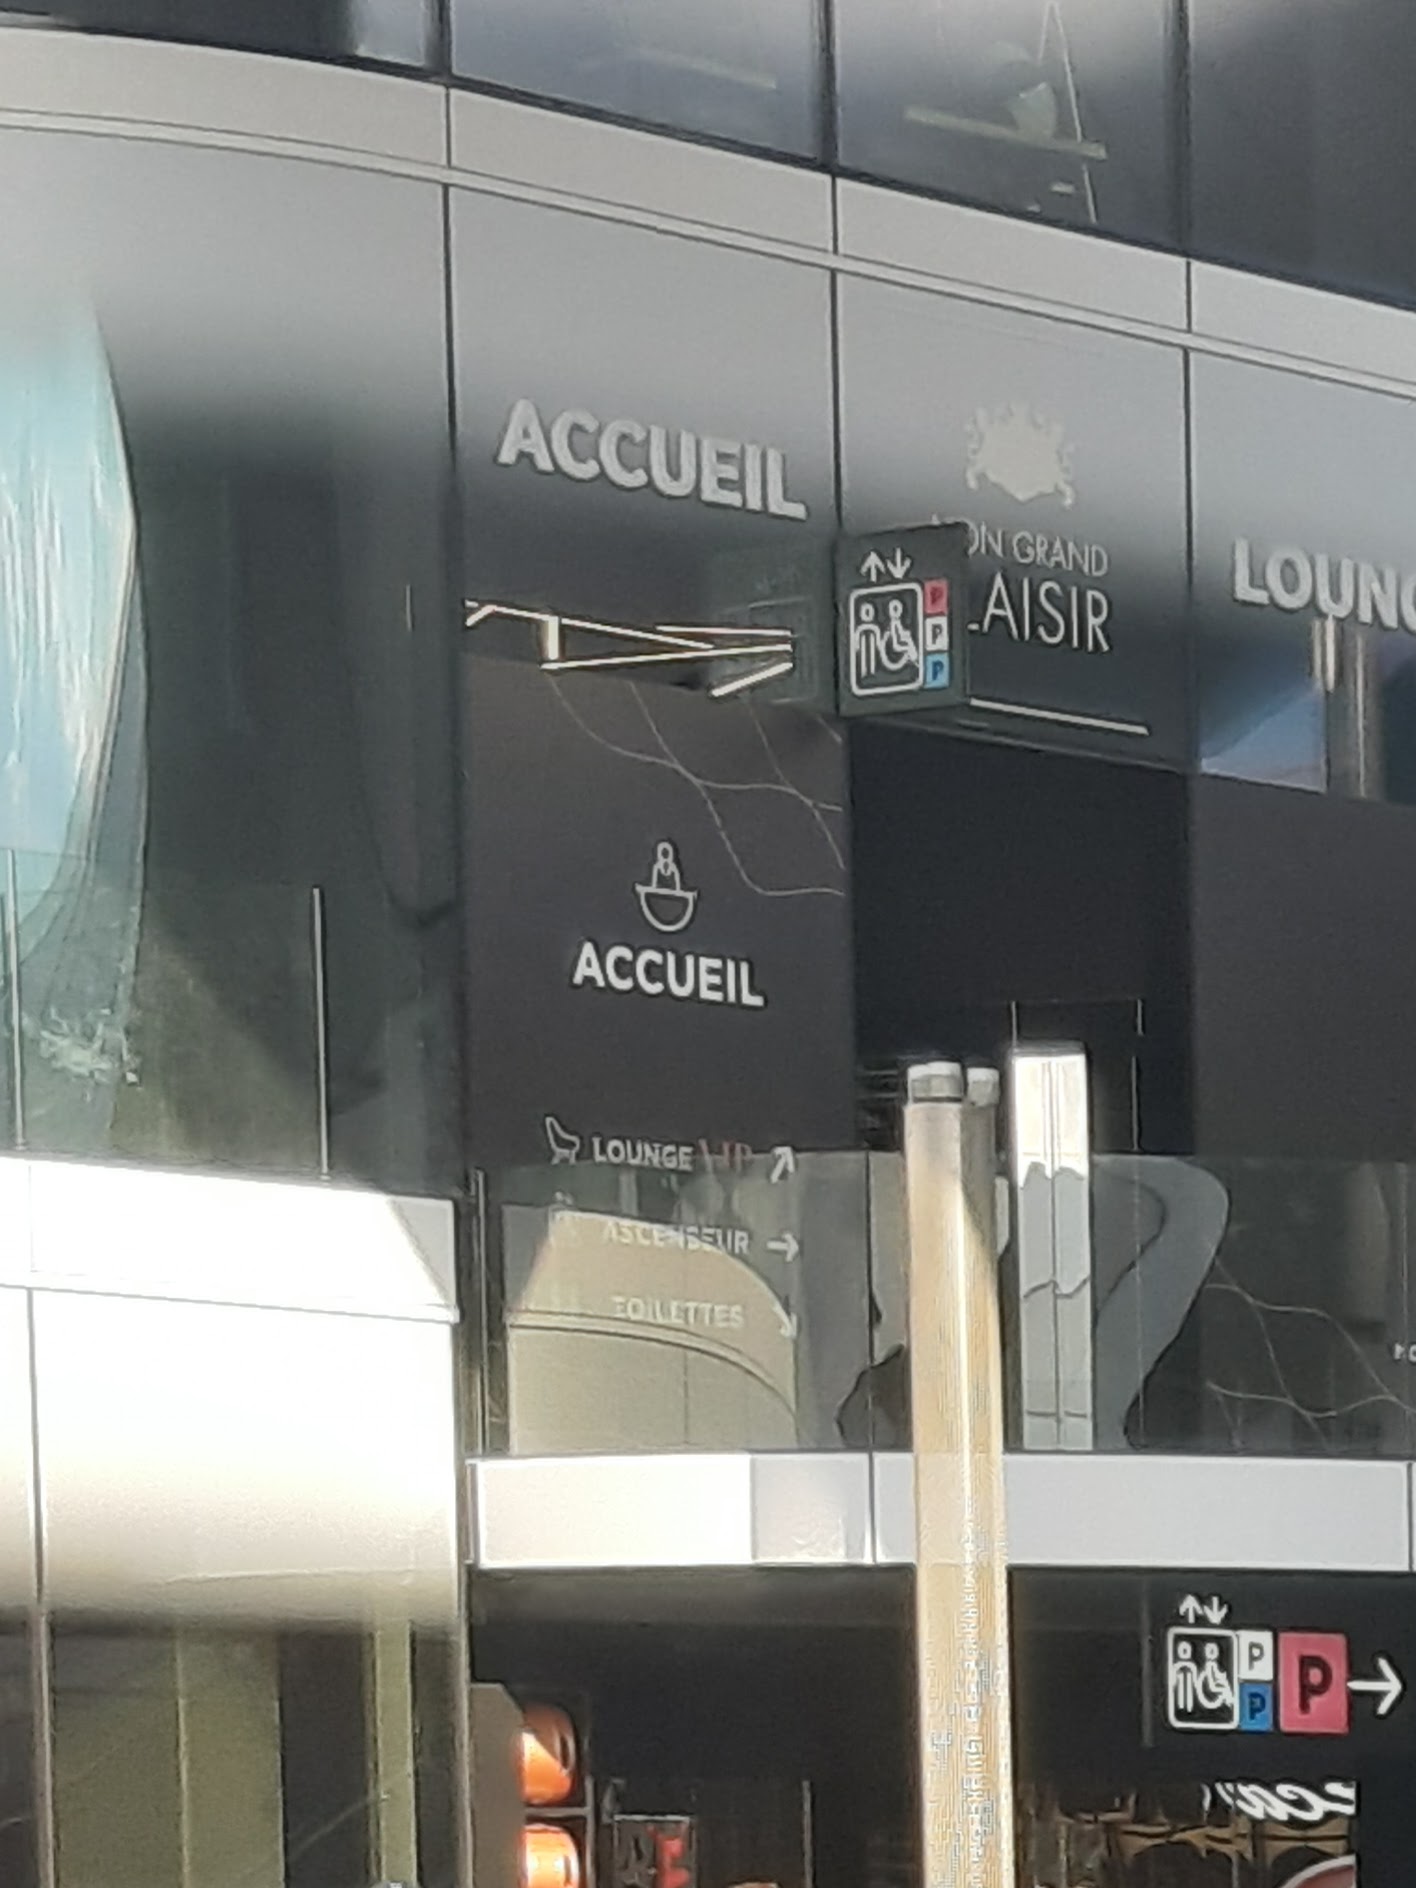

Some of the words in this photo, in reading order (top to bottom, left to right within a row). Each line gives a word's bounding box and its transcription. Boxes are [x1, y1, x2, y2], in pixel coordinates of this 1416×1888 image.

[498, 398, 807, 521] ACCUEIL
[1012, 531, 1108, 577] GRAND
[931, 586, 944, 606] P
[931, 623, 943, 645] P
[931, 660, 944, 681] P
[572, 942, 765, 1007] ACCUEIL
[591, 1135, 693, 1172] LOUNGE
[602, 1220, 749, 1254] ASCENSEUR
[1247, 1641, 1265, 1670] P
[1298, 1655, 1333, 1715] P
[1248, 1692, 1266, 1721] P
